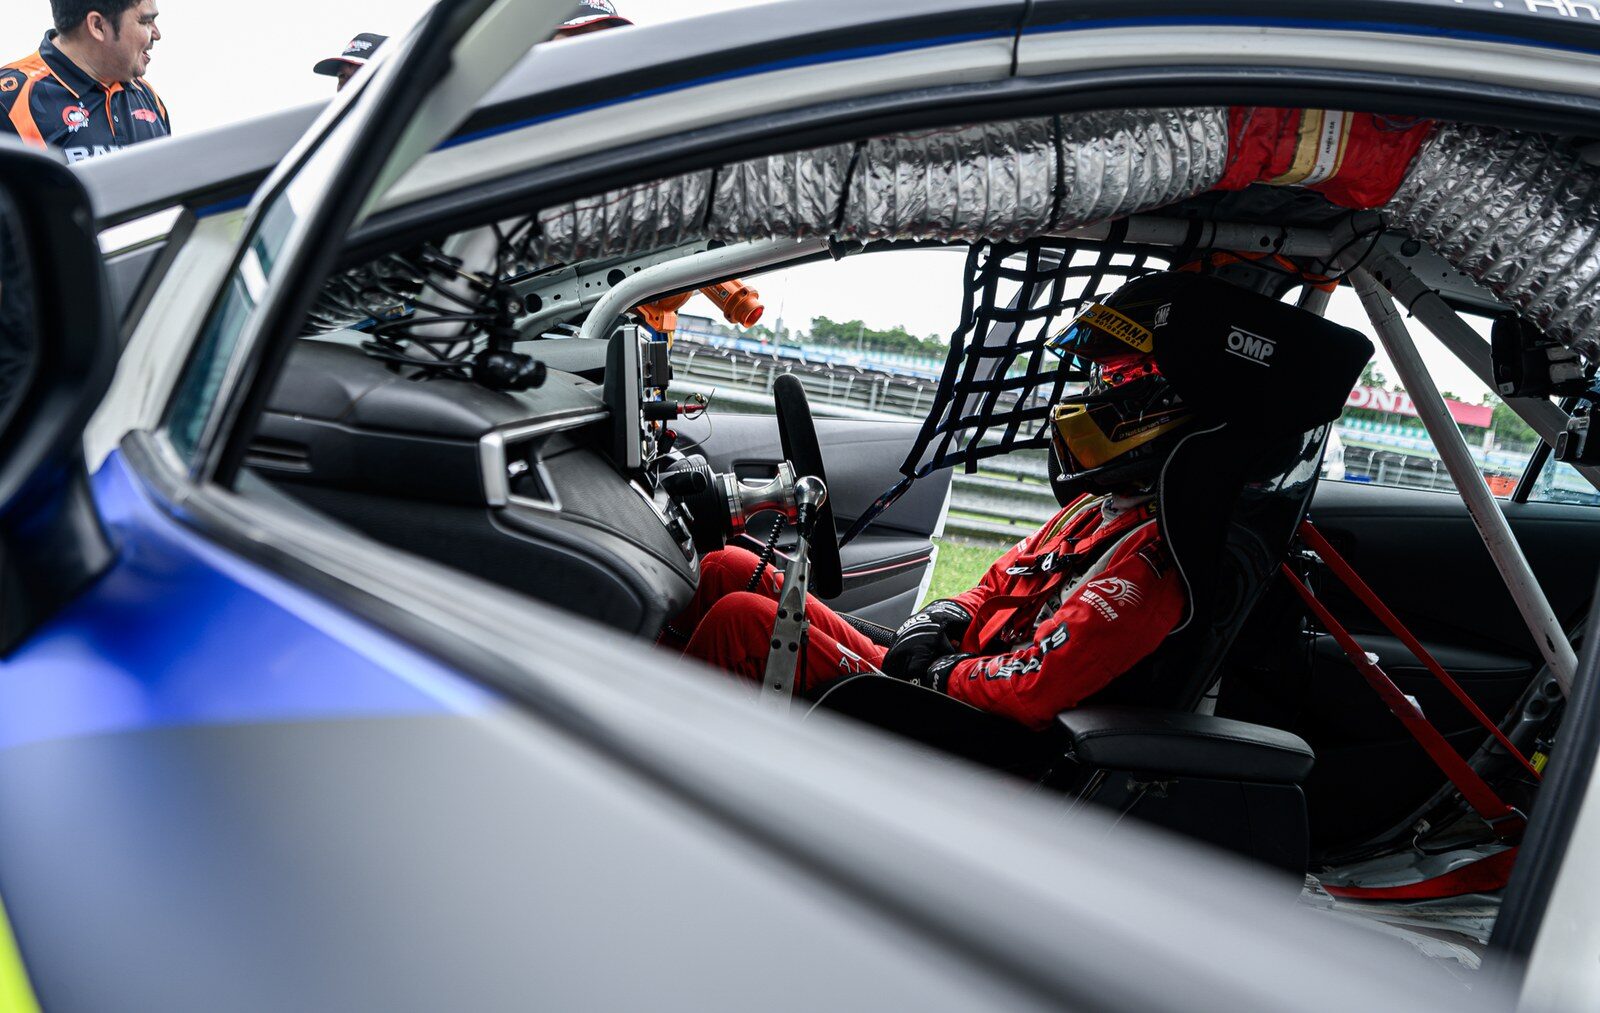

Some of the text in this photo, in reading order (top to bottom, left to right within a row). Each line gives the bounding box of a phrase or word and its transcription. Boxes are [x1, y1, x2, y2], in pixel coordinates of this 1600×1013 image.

[1098, 309, 1149, 344] VATTANA
[1154, 308, 1171, 326] OMP
[1095, 318, 1141, 348] MOTORSPORT
[1227, 330, 1274, 361] OMP
[1344, 386, 1419, 416] OND
[1083, 590, 1118, 619] VATTANA
